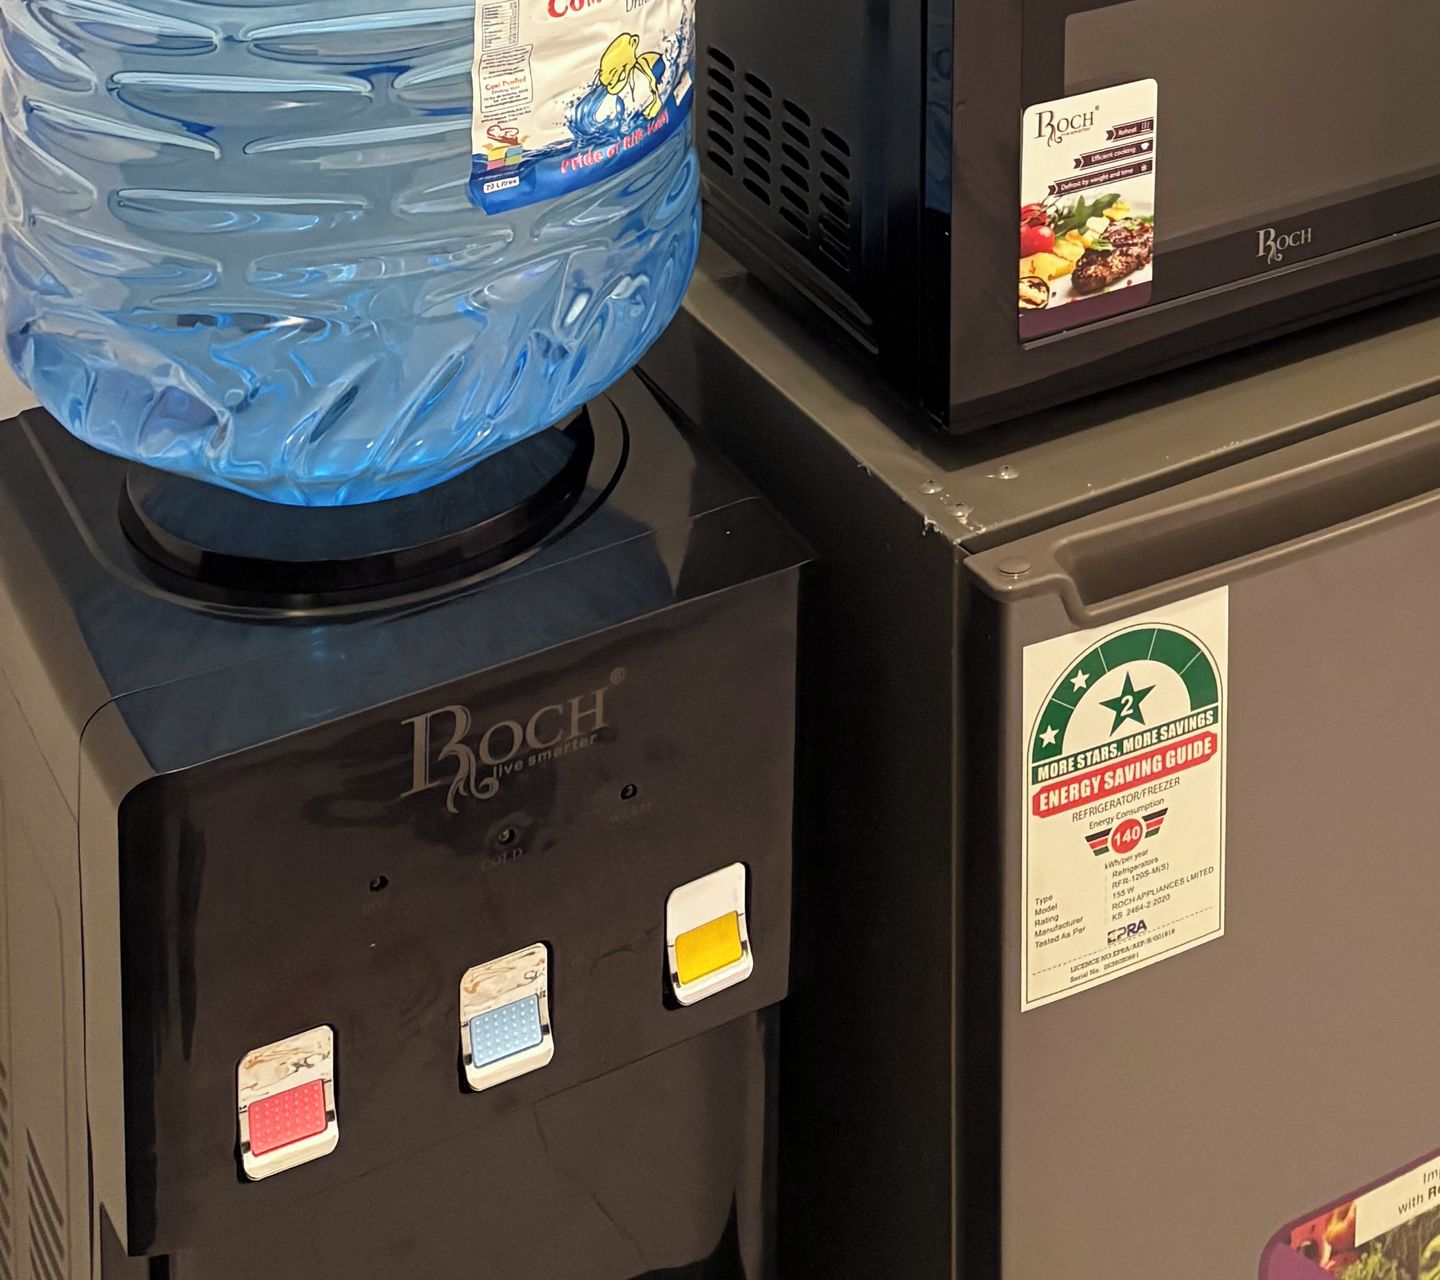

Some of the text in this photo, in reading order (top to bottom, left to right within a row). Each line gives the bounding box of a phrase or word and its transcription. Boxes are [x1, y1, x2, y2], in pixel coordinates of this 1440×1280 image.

[1118, 127, 1137, 135] Reheat
[561, 148, 603, 175] Pride
[607, 138, 621, 158] of
[1091, 147, 1137, 162] Efficient cooking
[1060, 180, 1081, 191] Defrost
[1082, 178, 1089, 186] by
[1110, 170, 1120, 178] and
[1121, 168, 1134, 176] time
[1255, 227, 1312, 265] ROCH
[1120, 695, 1134, 717] 2
[493, 734, 598, 778] live smarter
[1038, 710, 1214, 782] MORE STARS, MORE SAVINGS
[1040, 737, 1212, 812] ENERGY SAVING GUIDE
[1072, 777, 1180, 822] REFRIGERATOR/FREEZER
[1089, 798, 1164, 830] Energy Consumption
[1114, 826, 1140, 847] 140
[1135, 849, 1149, 861] year
[1112, 857, 1159, 878] Refrigerators
[1035, 895, 1053, 905] Type
[1112, 897, 1135, 910] ROCH
[1136, 877, 1185, 901] APPLIANCES
[1127, 886, 1135, 894] W
[1035, 902, 1058, 916] Model
[1035, 915, 1059, 927] Rating
[1035, 916, 1084, 937] Manufacturer
[1107, 919, 1147, 945] EPRA
[1036, 926, 1086, 948] Tested As Per
[1397, 1193, 1424, 1215] with
